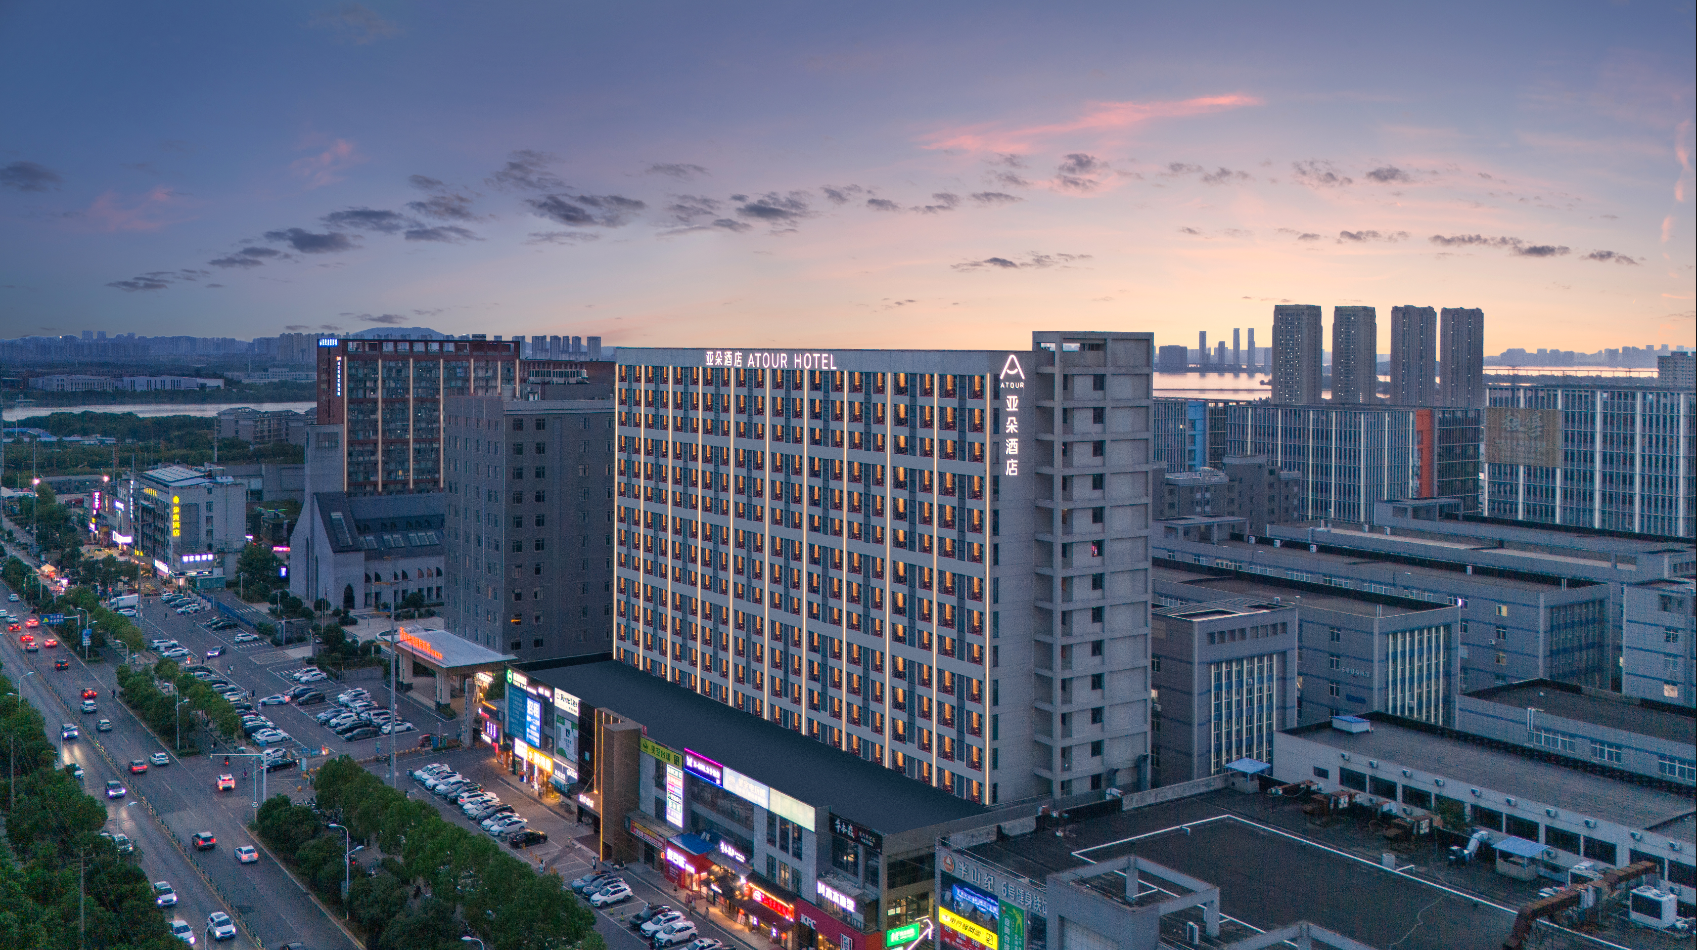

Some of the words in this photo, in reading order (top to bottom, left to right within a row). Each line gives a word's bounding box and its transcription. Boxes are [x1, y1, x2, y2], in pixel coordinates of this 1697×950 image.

[706, 351, 743, 367] 亚朵酒店
[747, 352, 788, 369] ATOUR
[794, 353, 837, 370] HOTEL
[1005, 395, 1019, 476] 亚朵酒店
[958, 860, 994, 892] 半山纪
[800, 913, 817, 930] KFC
